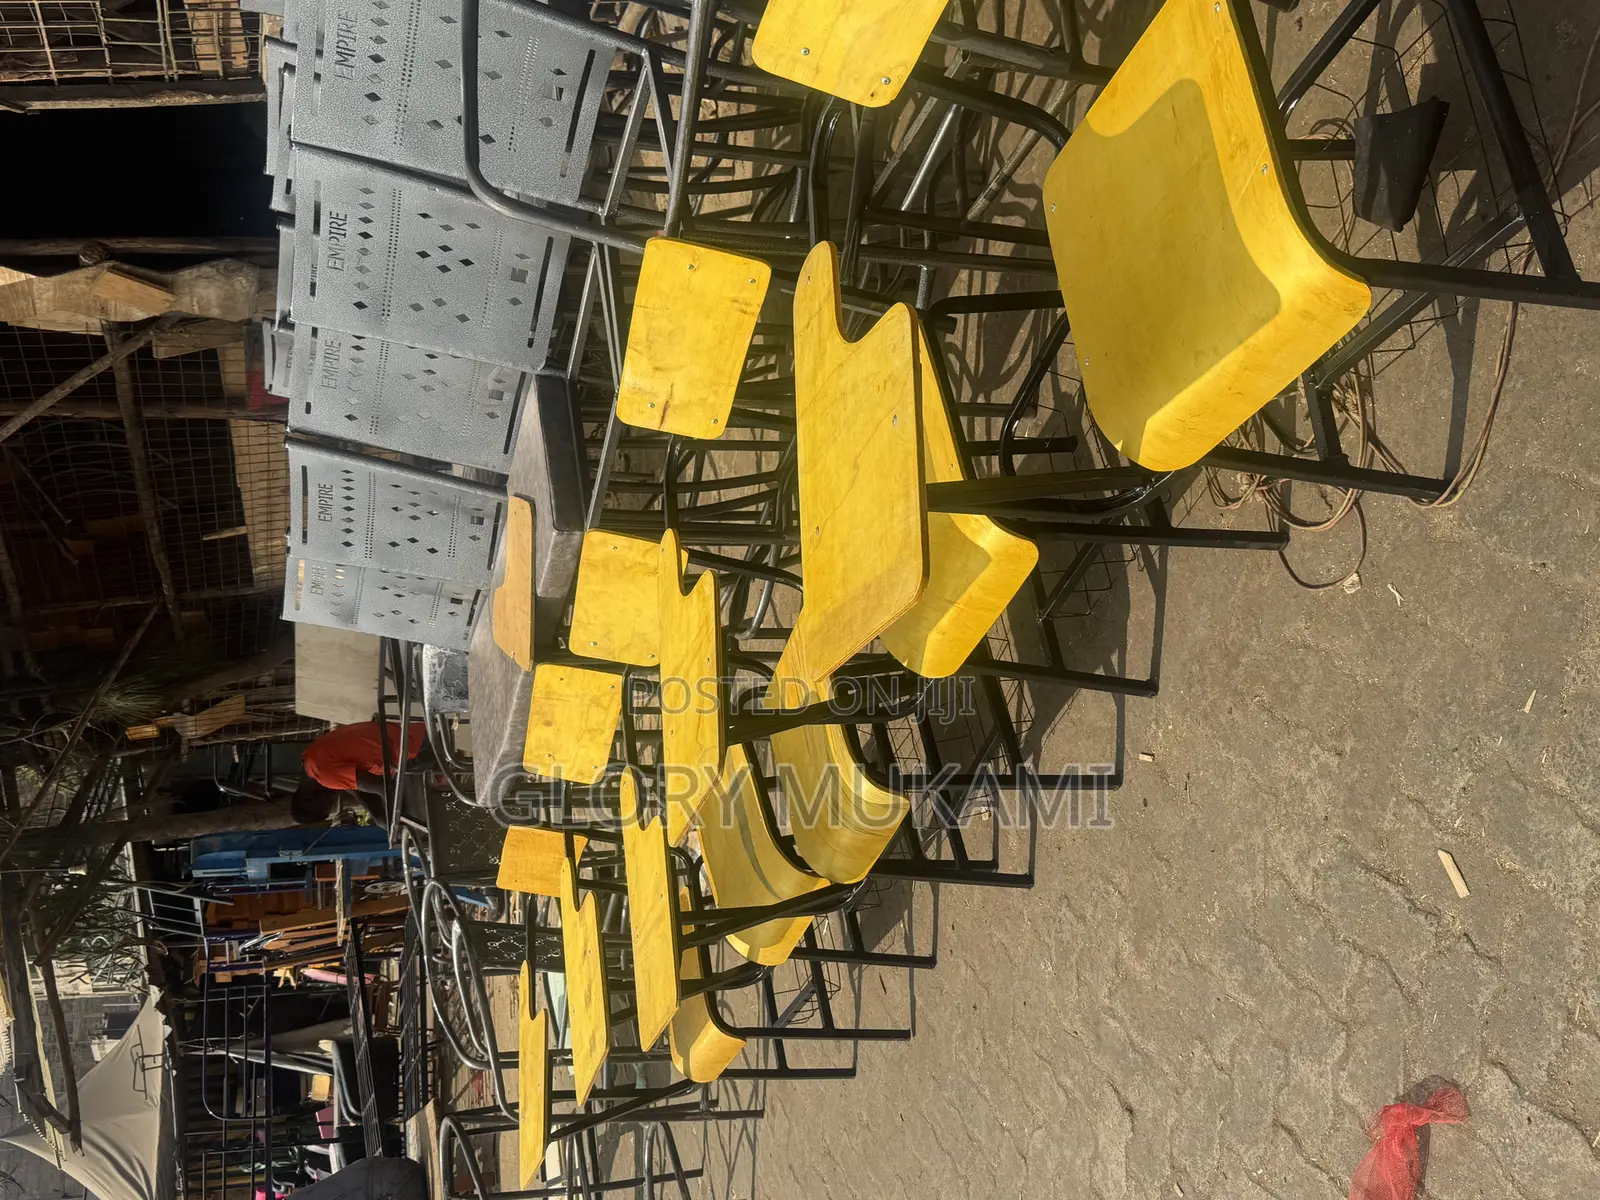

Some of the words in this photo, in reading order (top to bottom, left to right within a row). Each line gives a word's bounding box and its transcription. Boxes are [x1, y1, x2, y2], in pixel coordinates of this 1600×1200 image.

[333, 11, 358, 80] EMPIRE
[327, 211, 347, 271] EMPIRE
[321, 340, 341, 390] EMPIRE
[318, 483, 333, 523] EMPIRE
